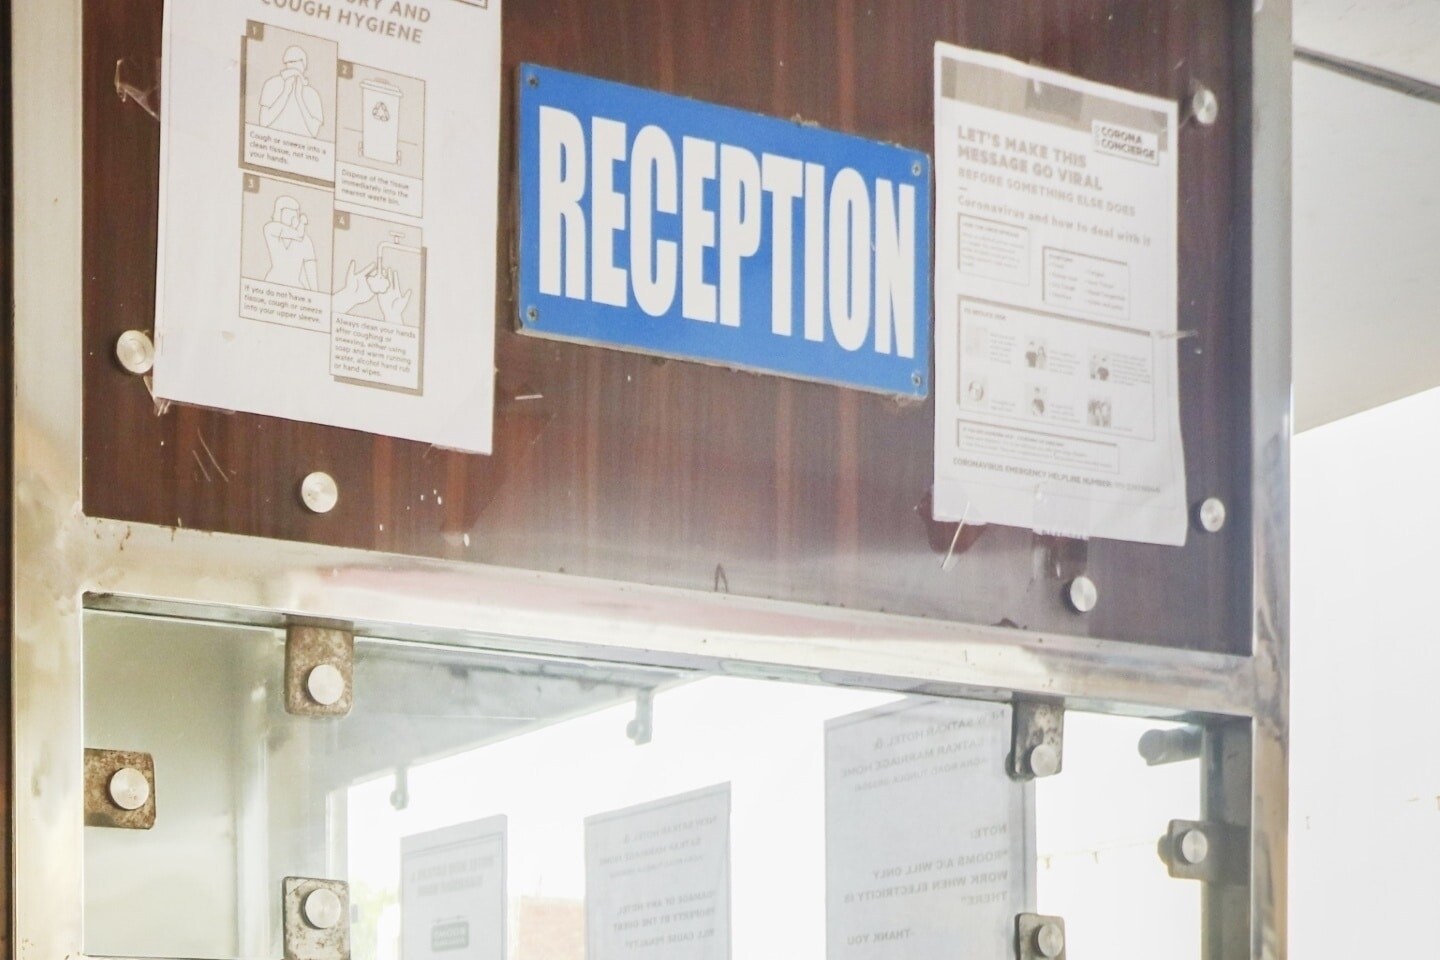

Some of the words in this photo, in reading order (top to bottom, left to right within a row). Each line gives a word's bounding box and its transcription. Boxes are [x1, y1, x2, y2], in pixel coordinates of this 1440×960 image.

[390, 1, 431, 23] AND
[338, 9, 423, 43] HYGIENE
[250, 131, 271, 142] Cough
[1102, 127, 1142, 143] CORONA
[250, 141, 267, 150] clean
[957, 125, 1000, 147] LET'S
[1005, 137, 1048, 159] MAKE
[1053, 148, 1086, 168] THIS
[342, 169, 367, 179] Dispose
[958, 145, 1028, 173] MESSAGE
[1033, 159, 1052, 178] GO
[1059, 166, 1103, 191] VIRAL
[958, 167, 1003, 187] BEFORE
[1007, 176, 1074, 203] SOMETHING
[1077, 192, 1104, 208] ELSE
[1106, 200, 1135, 216] DOES
[958, 195, 1025, 219] Coronavirus
[1028, 210, 1049, 224] and
[1052, 215, 1073, 229] how
[1076, 221, 1088, 233] to
[1091, 224, 1114, 239] deal
[1117, 230, 1144, 245] with
[538, 105, 915, 359] RECEPTION
[269, 300, 288, 308] cough
[289, 292, 305, 301] have
[336, 318, 359, 328] Always
[396, 329, 415, 338] hands
[353, 331, 383, 342] coughing
[343, 364, 360, 372] hand
[381, 362, 397, 370] hand
[386, 355, 411, 365] running
[953, 457, 1003, 472] CORONAVIRUS
[1005, 465, 1046, 478] EMERGENCY
[1048, 471, 1081, 483] HELPLINE
